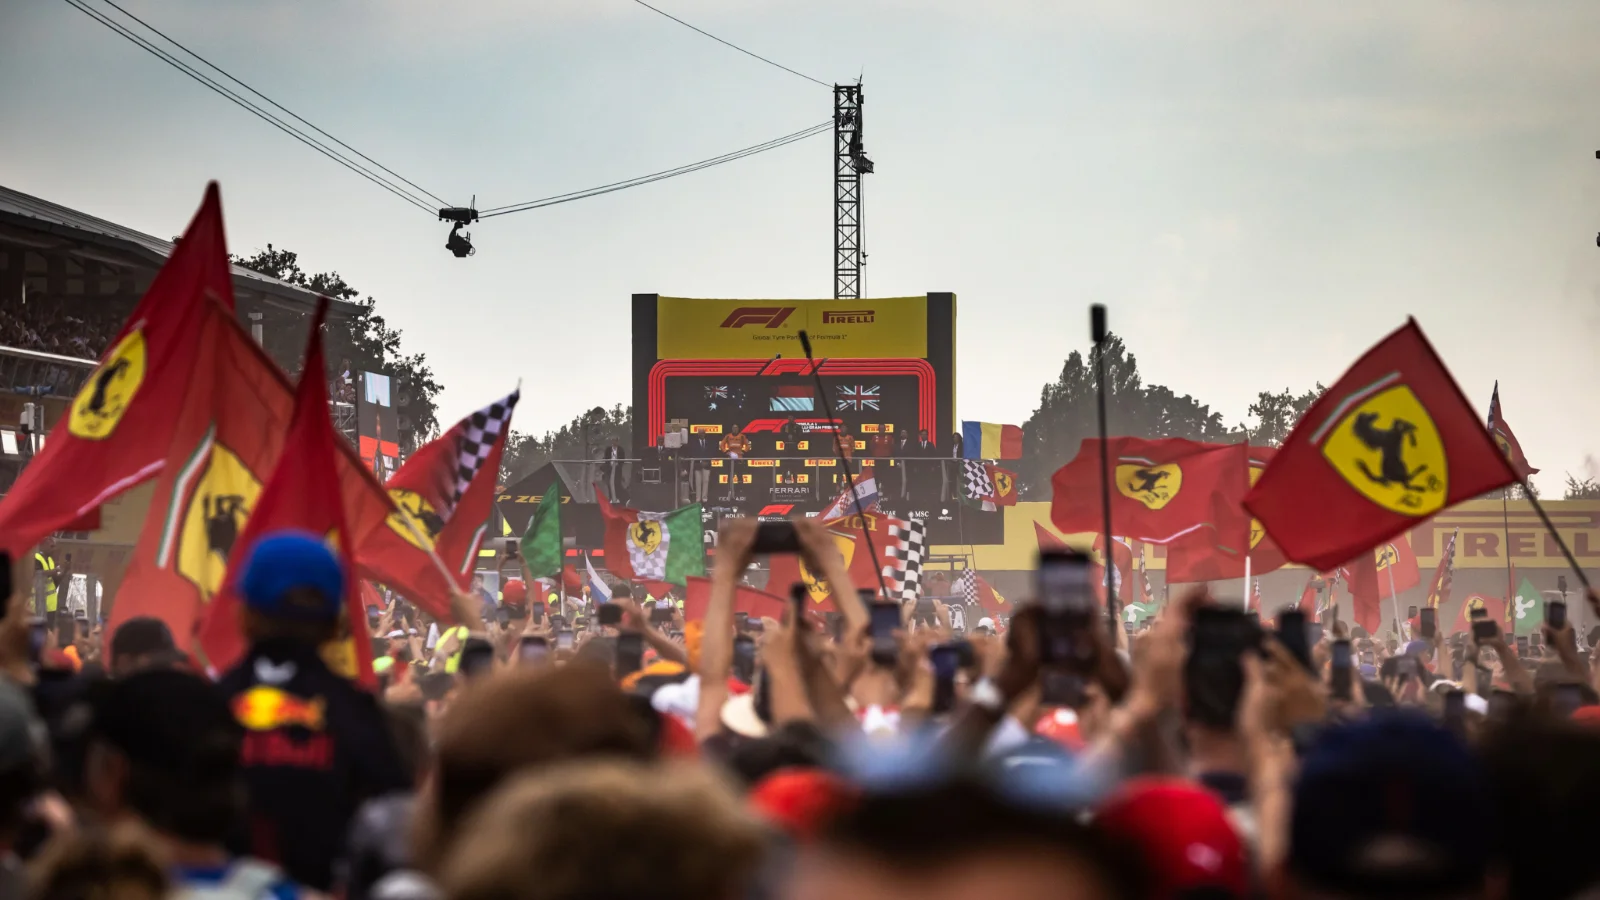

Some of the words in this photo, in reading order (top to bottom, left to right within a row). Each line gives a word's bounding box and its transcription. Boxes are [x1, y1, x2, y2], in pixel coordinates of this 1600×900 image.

[823, 310, 875, 324] PIRELLI
[514, 495, 571, 504] ZEO
[914, 510, 930, 518] MSC
